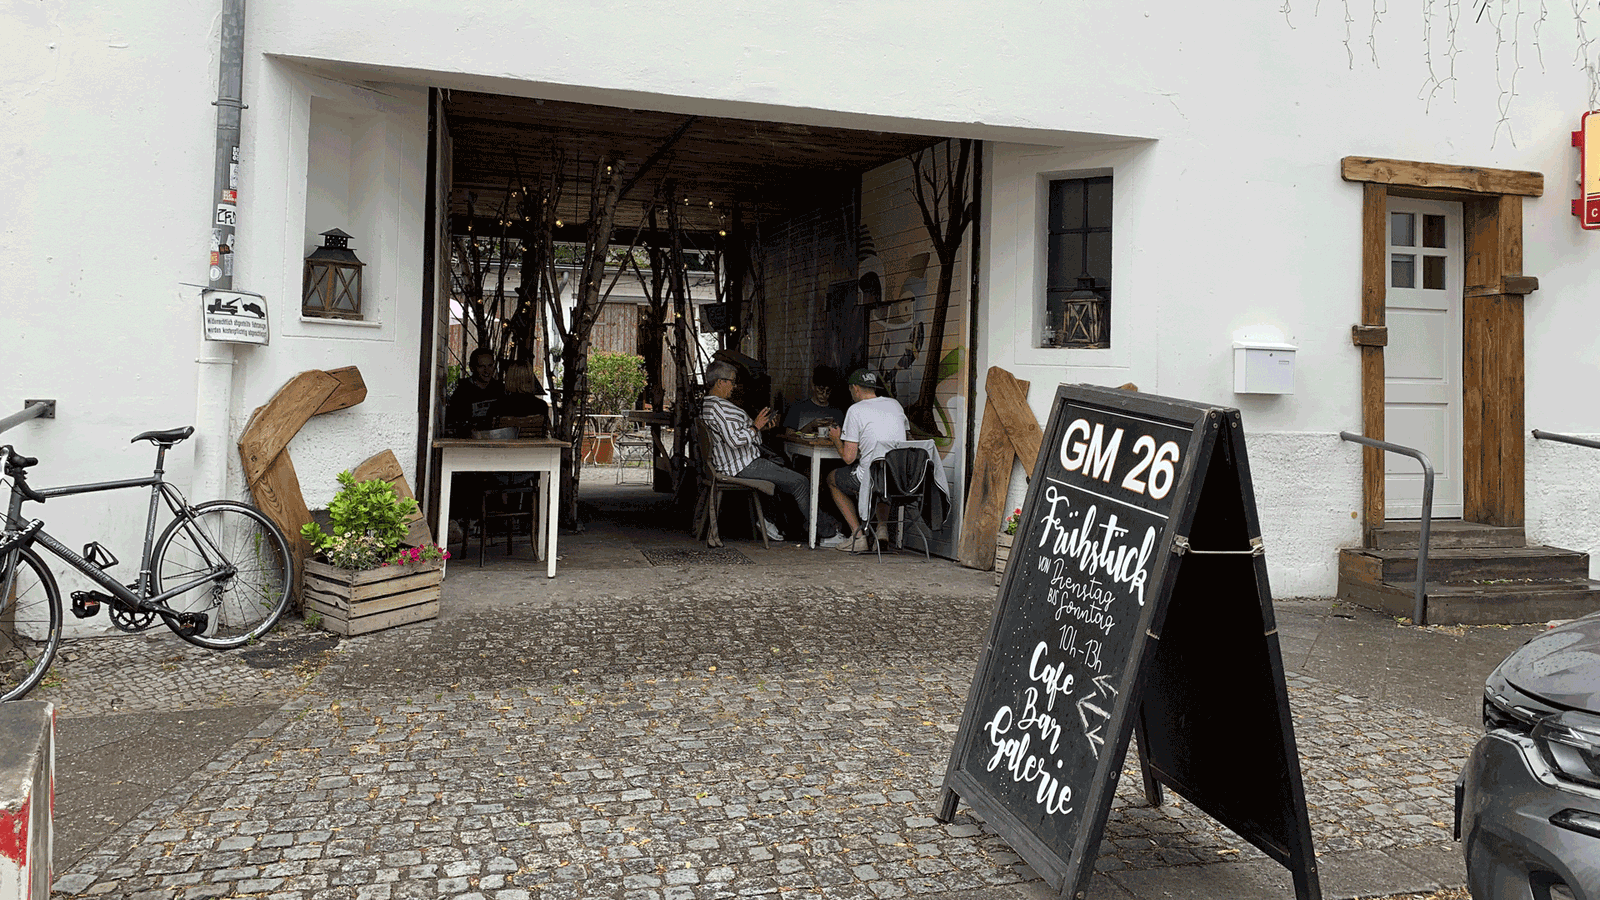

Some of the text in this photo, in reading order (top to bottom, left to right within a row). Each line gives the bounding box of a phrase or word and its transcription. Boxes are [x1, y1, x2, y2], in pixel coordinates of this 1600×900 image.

[1060, 418, 1180, 500] GM 26
[1038, 485, 1156, 606] Frühstück
[1038, 555, 1116, 612] VON Dienstag
[1047, 587, 1116, 636] BIS Sonntag
[1029, 641, 1074, 712] Cafe
[1017, 686, 1062, 755] Bar
[984, 705, 1073, 815] Galerie
